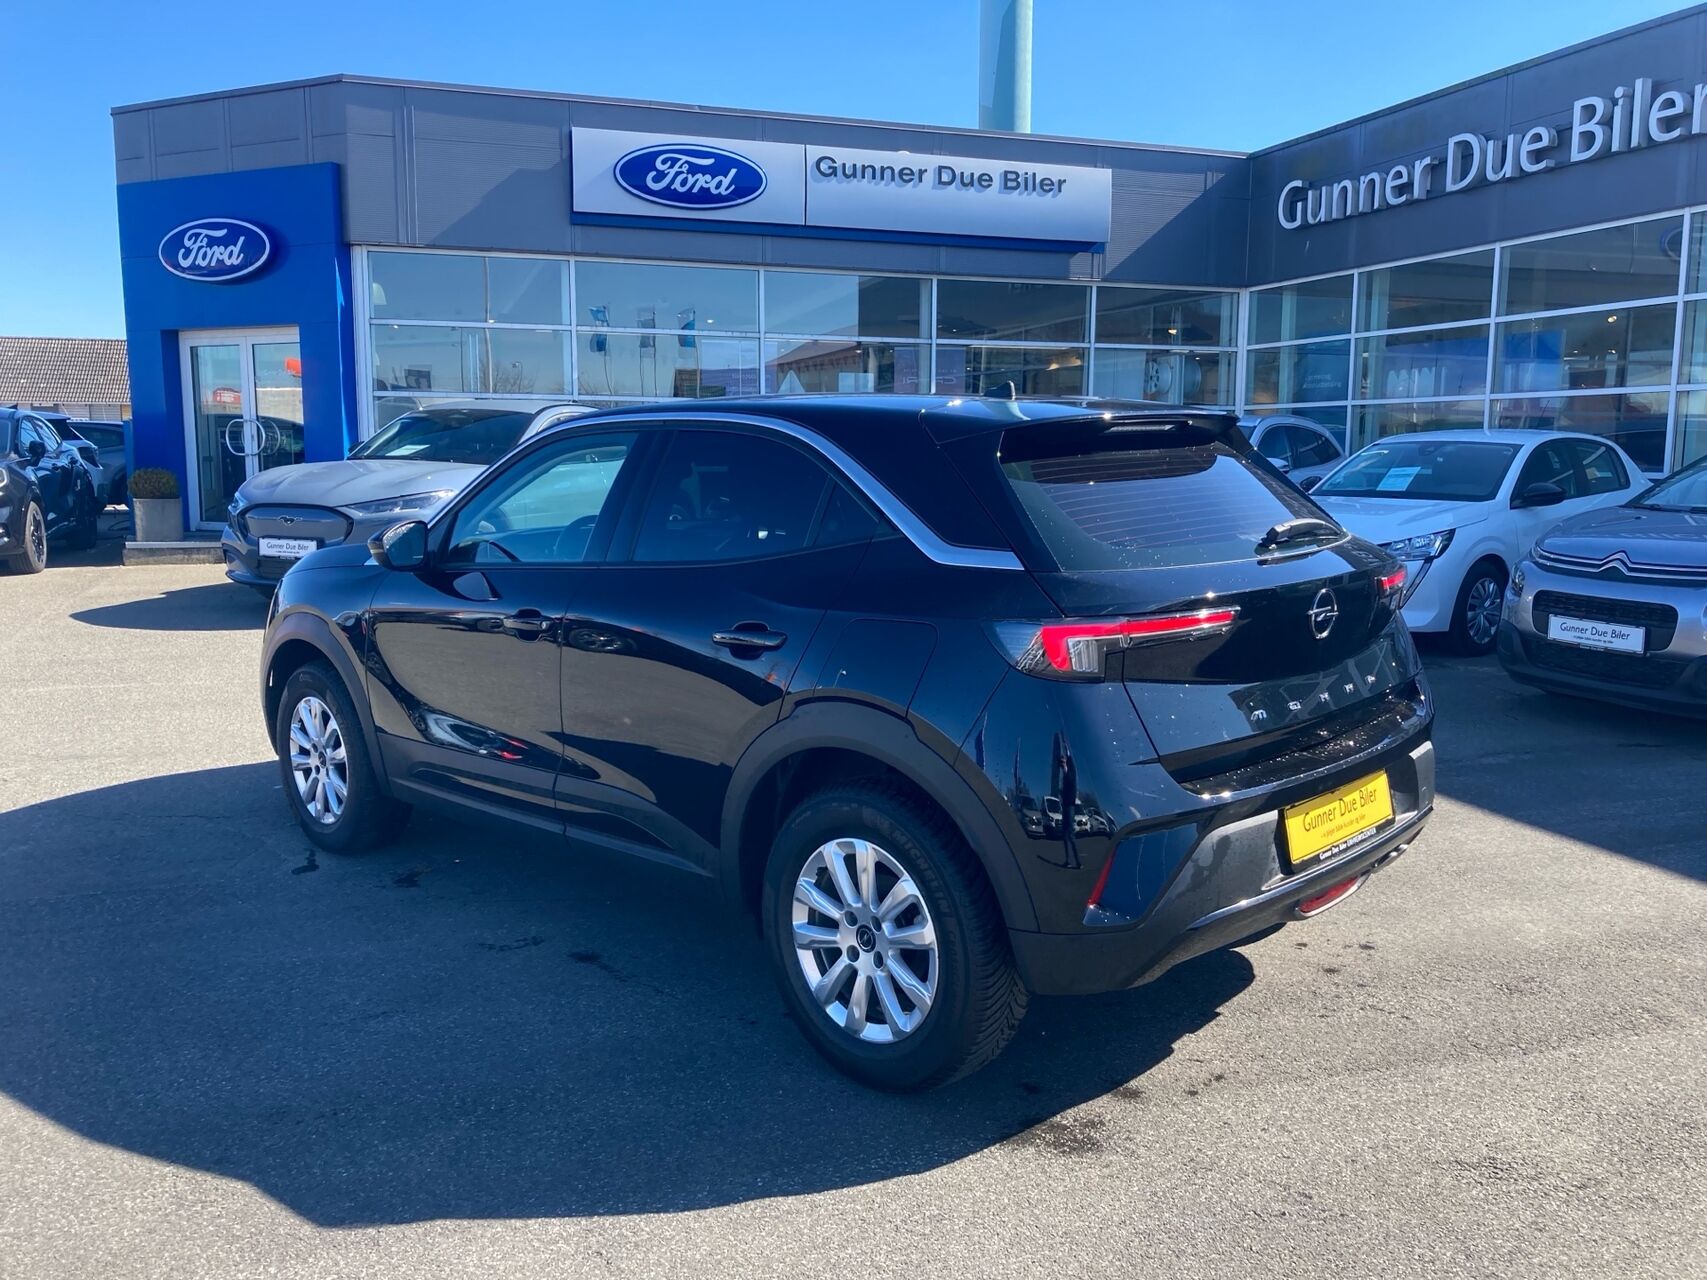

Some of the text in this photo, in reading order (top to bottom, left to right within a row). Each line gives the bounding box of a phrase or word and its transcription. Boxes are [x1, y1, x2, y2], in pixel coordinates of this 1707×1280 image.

[646, 153, 737, 196] Ford
[815, 155, 1067, 193] Gunner Due Biler
[1277, 154, 1437, 230] Gunner
[1446, 126, 1556, 192] Due
[178, 228, 245, 268] Ford
[1559, 621, 1588, 635] Gunner
[1590, 626, 1608, 638] Due
[1610, 628, 1631, 640] Biler
[1303, 806, 1337, 832] Gunner
[1338, 798, 1357, 816] Due
[1358, 787, 1377, 807] Biler
